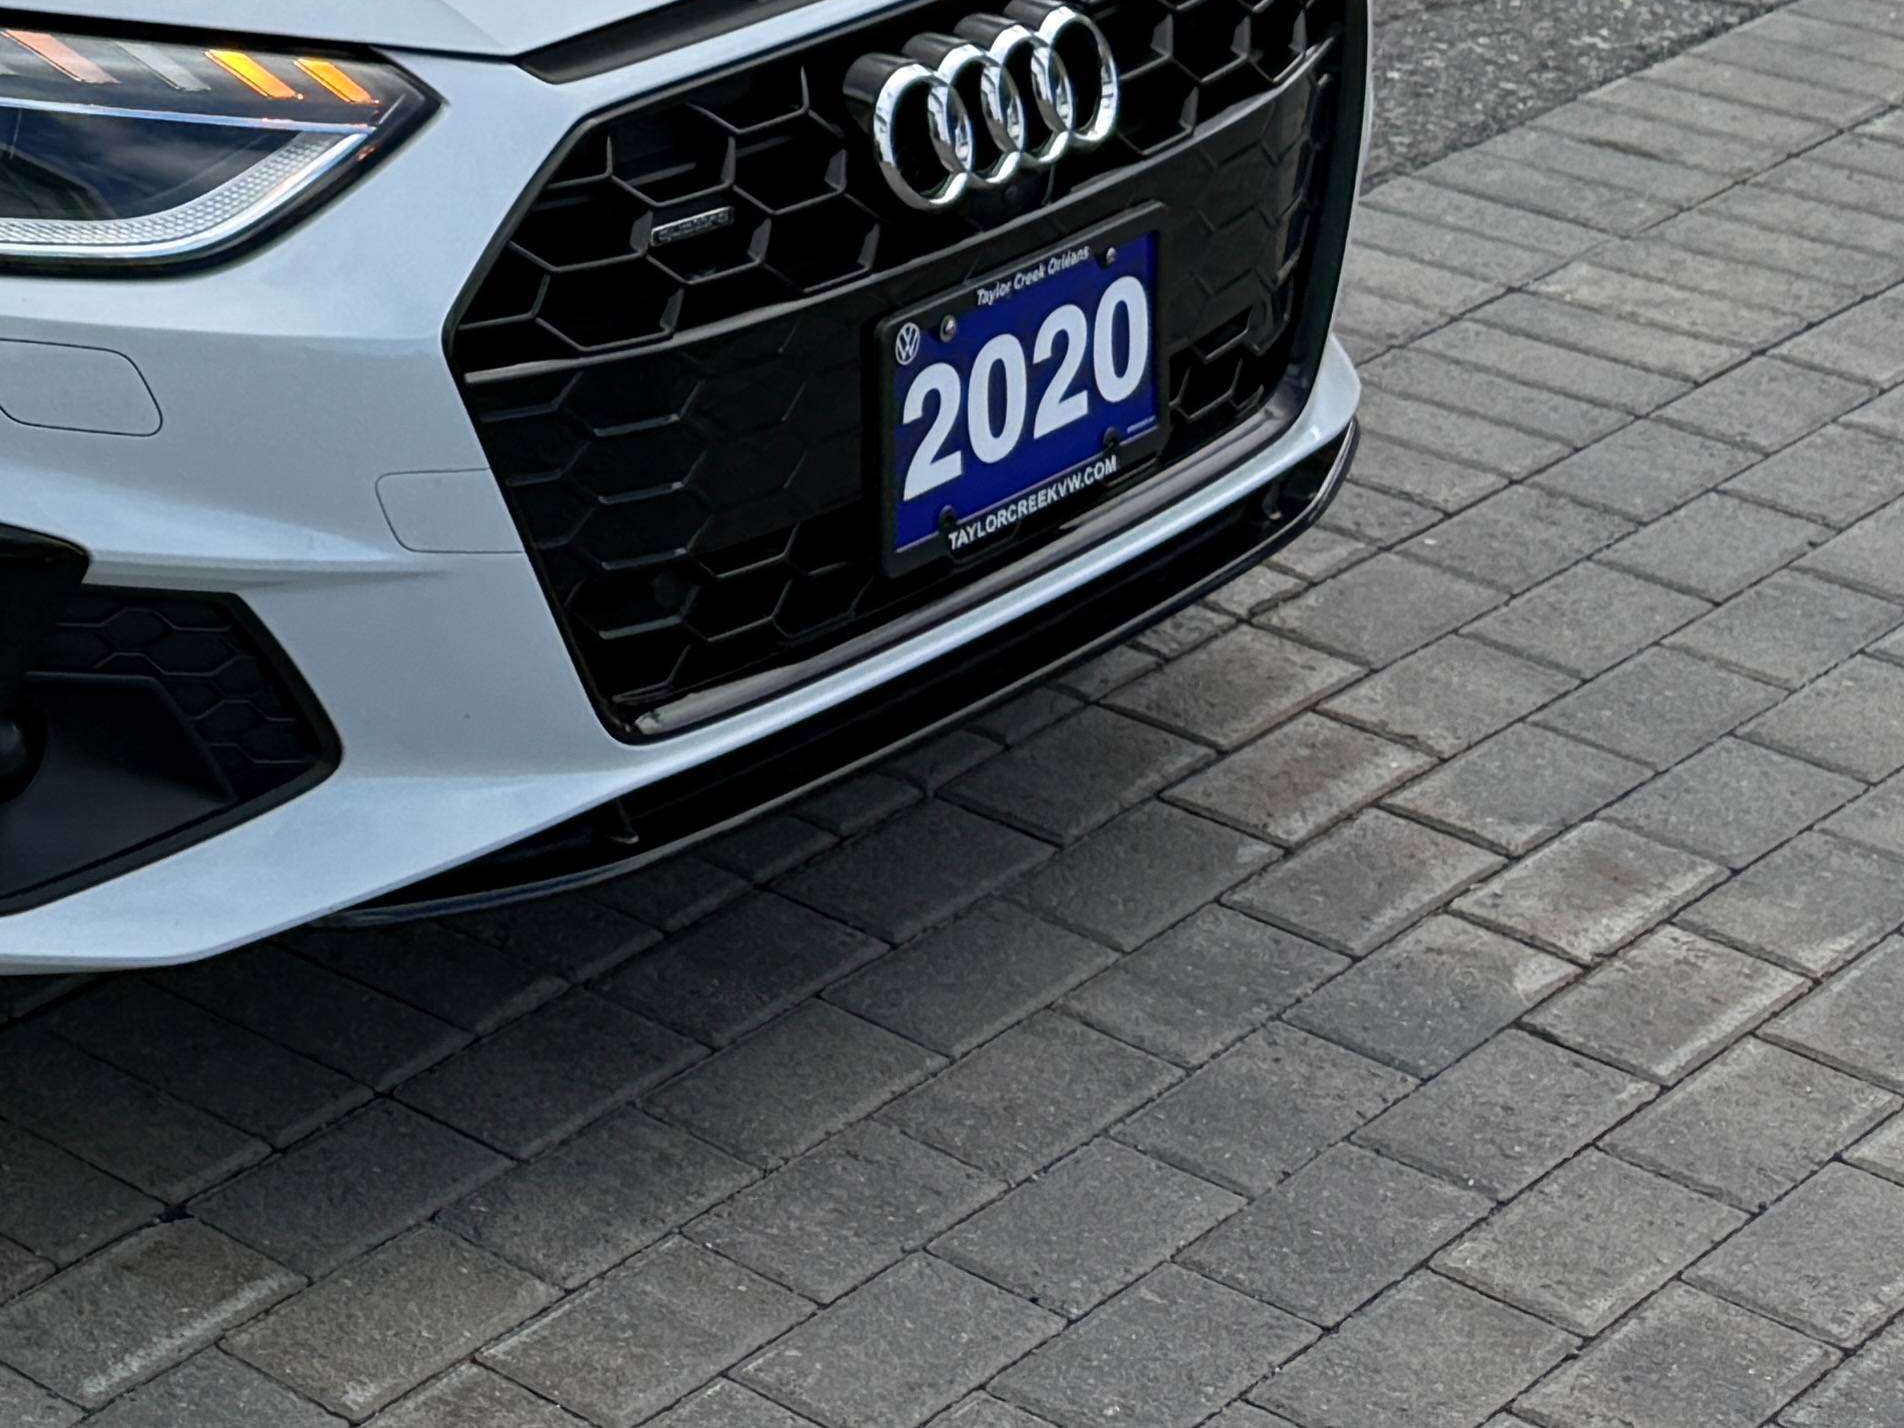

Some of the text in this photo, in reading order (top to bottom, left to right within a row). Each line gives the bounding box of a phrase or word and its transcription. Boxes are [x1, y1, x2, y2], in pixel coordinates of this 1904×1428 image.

[976, 280, 1012, 306] Taylor
[1013, 263, 1046, 290] Creek
[903, 275, 1149, 502] 2020
[948, 454, 1118, 551] TAYLORCREEKVW.COM
